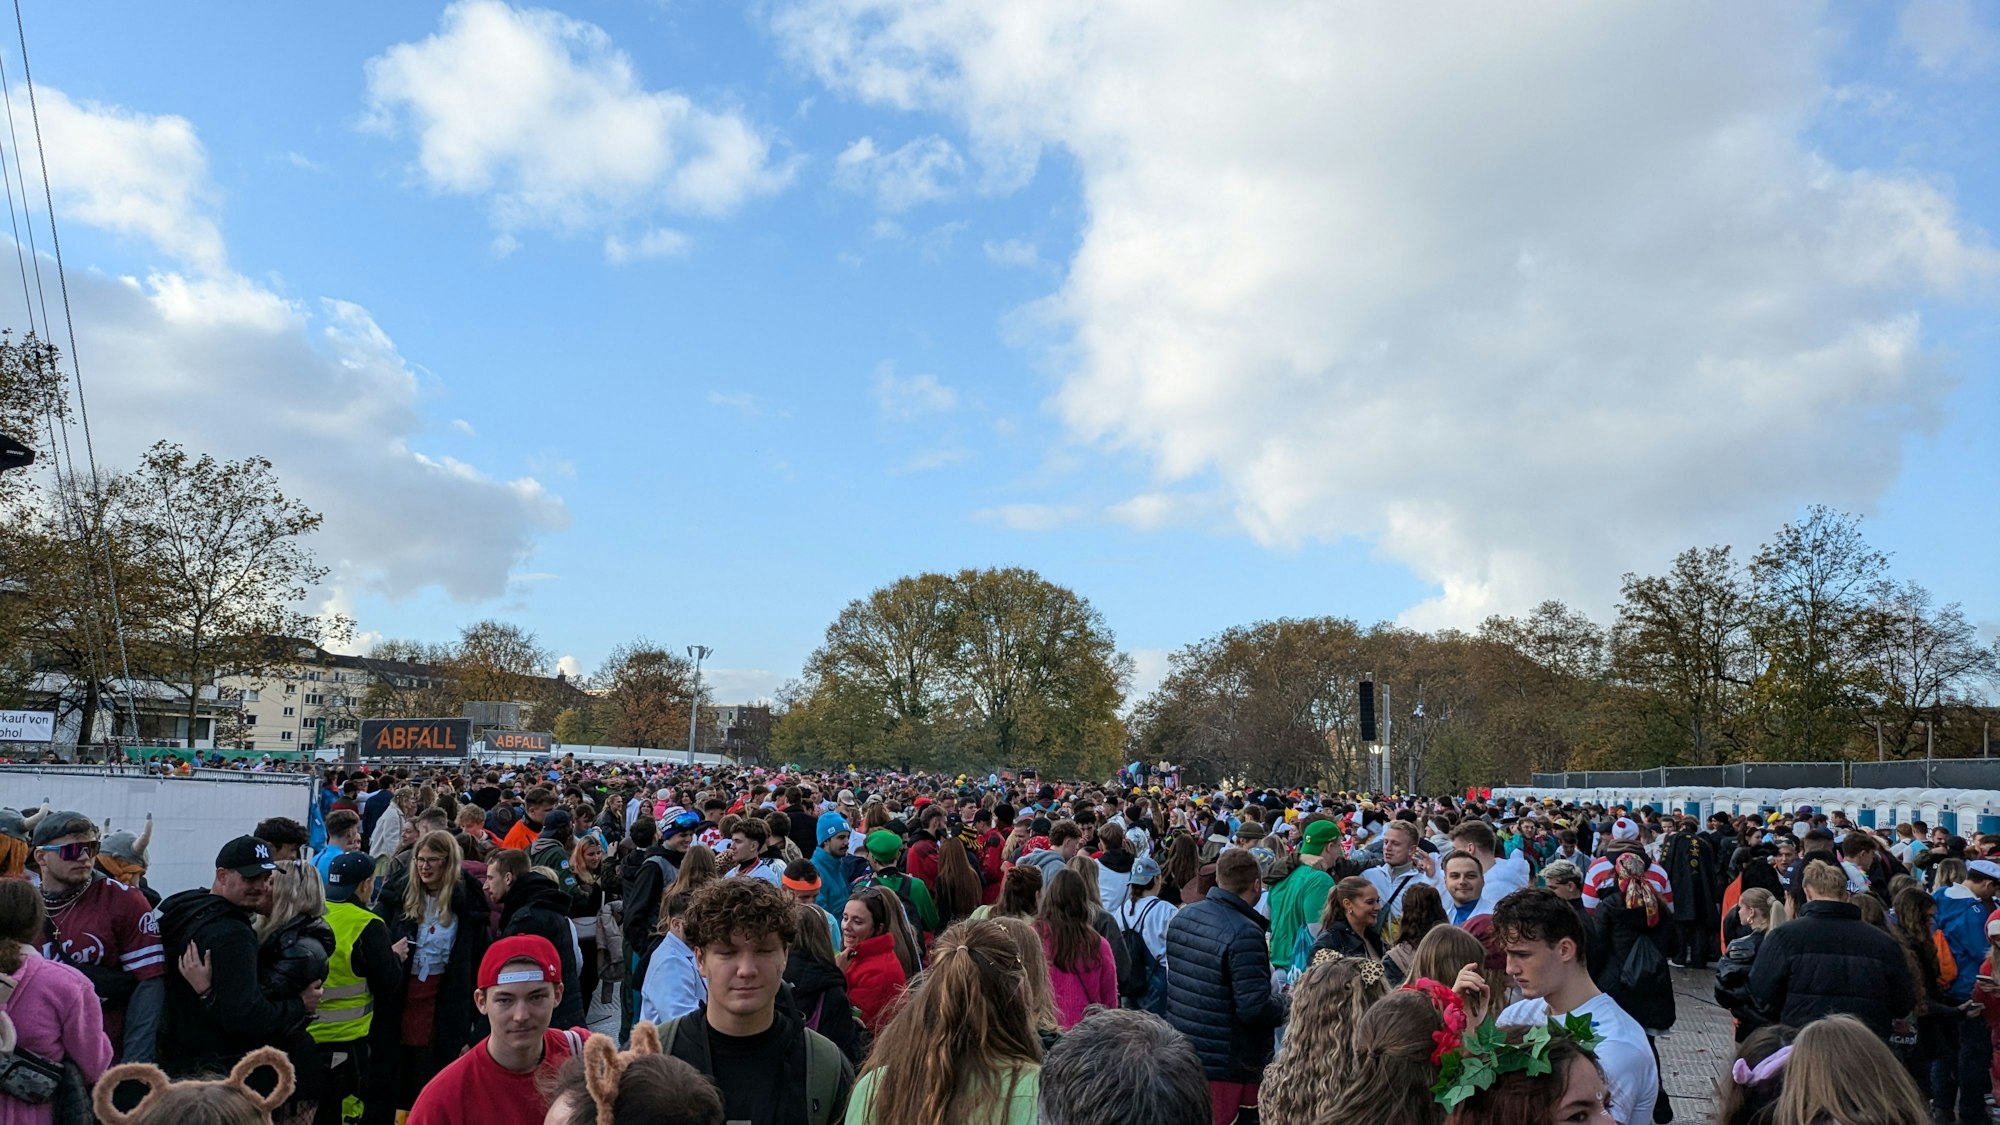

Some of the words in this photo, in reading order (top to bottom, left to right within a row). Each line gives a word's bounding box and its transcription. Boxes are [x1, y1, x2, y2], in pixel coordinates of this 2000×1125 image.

[29, 715, 49, 724] von
[376, 726, 457, 750] ABFALL
[495, 734, 546, 750] ABFALL
[255, 844, 269, 859] NY
[329, 873, 341, 883] CAT
